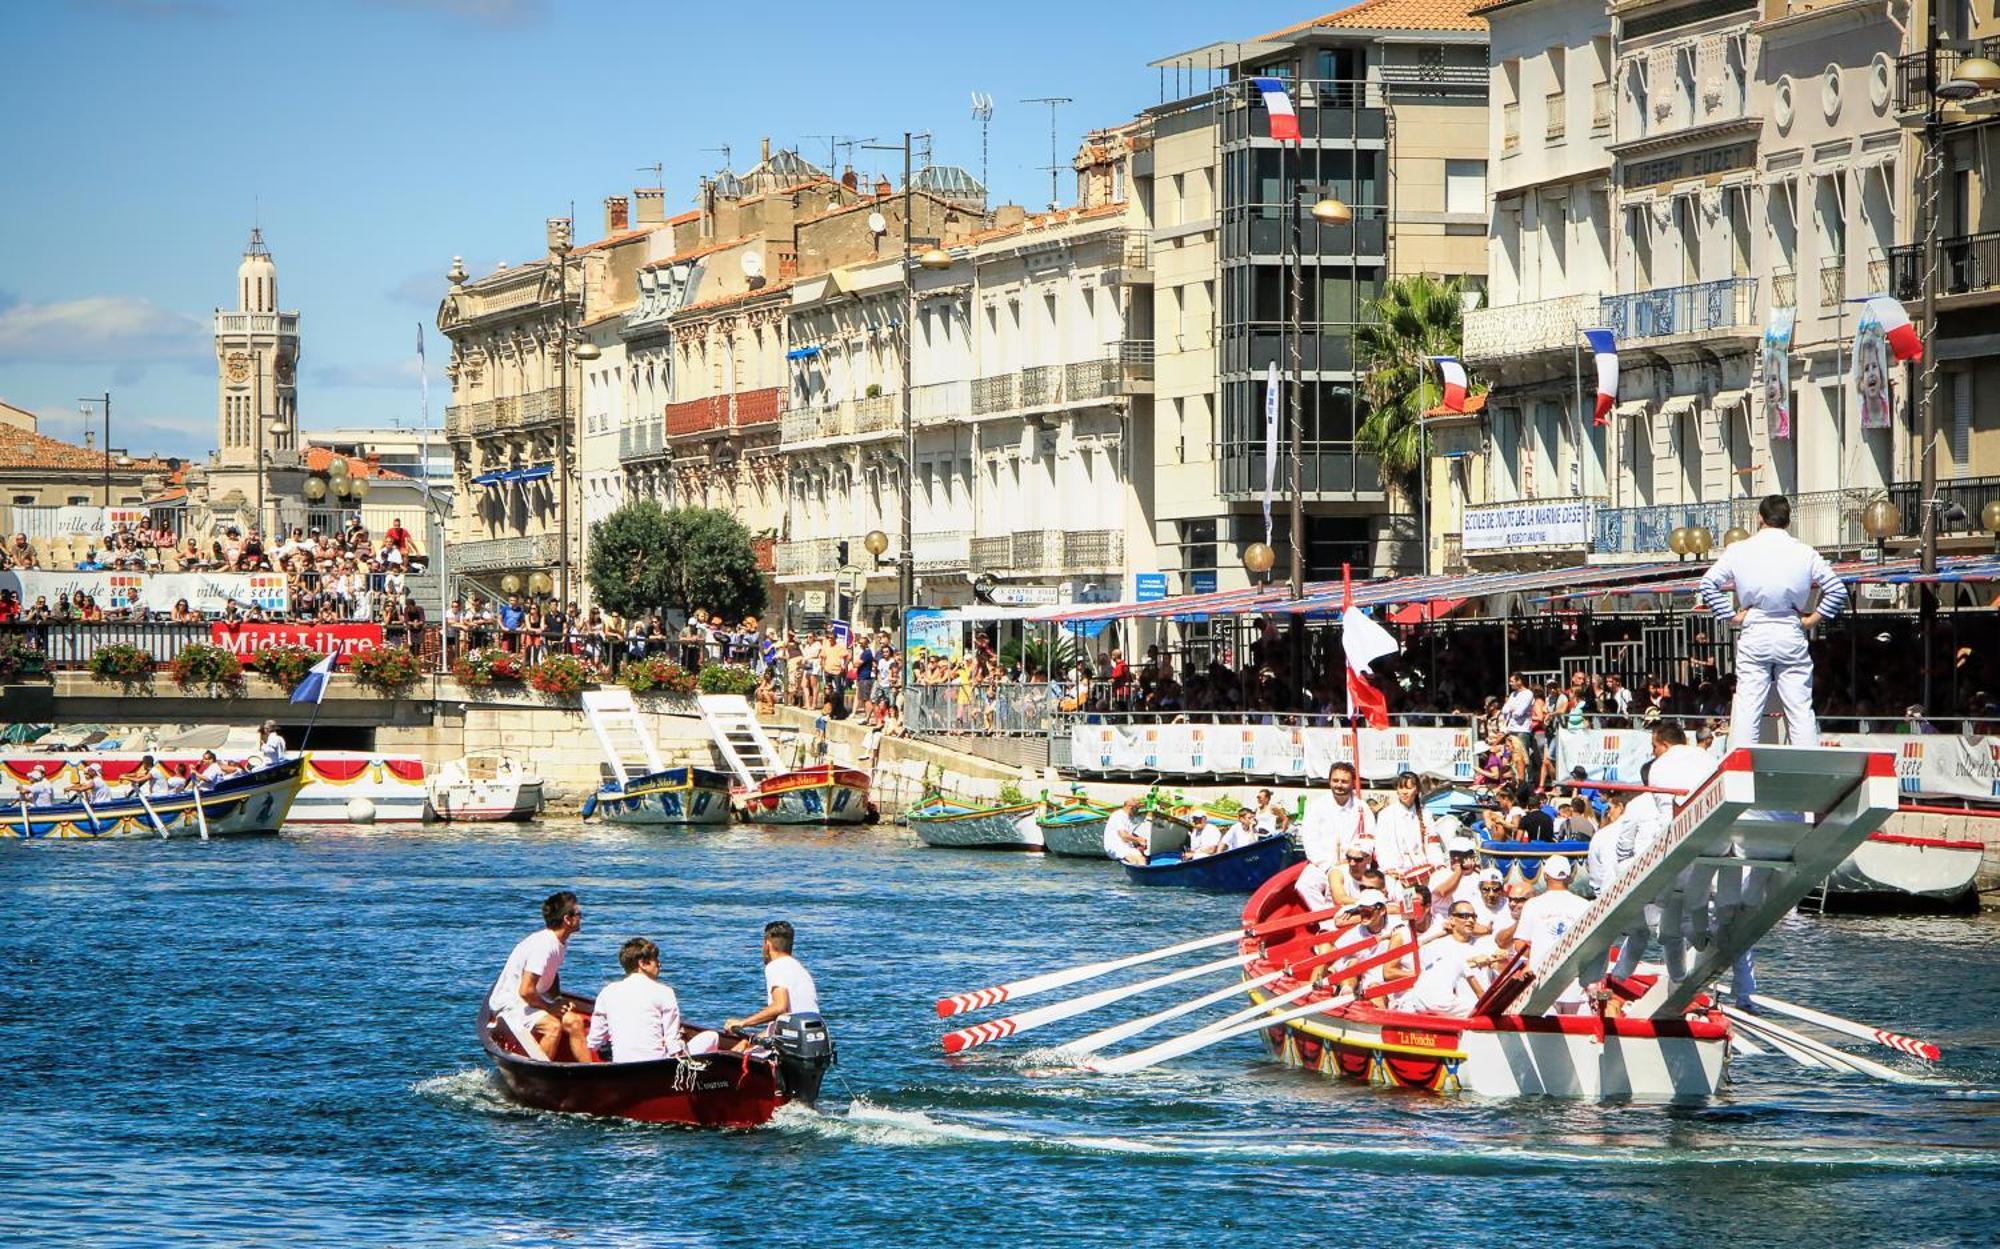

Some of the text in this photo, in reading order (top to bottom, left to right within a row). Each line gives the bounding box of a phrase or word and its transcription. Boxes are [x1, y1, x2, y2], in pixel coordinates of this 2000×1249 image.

[58, 516, 87, 531] ville
[91, 516, 105, 531] de
[1516, 509, 1526, 526] DE
[89, 581, 104, 596] de
[197, 582, 226, 598] ville
[228, 583, 245, 598] de
[219, 632, 373, 655] Midi Libre
